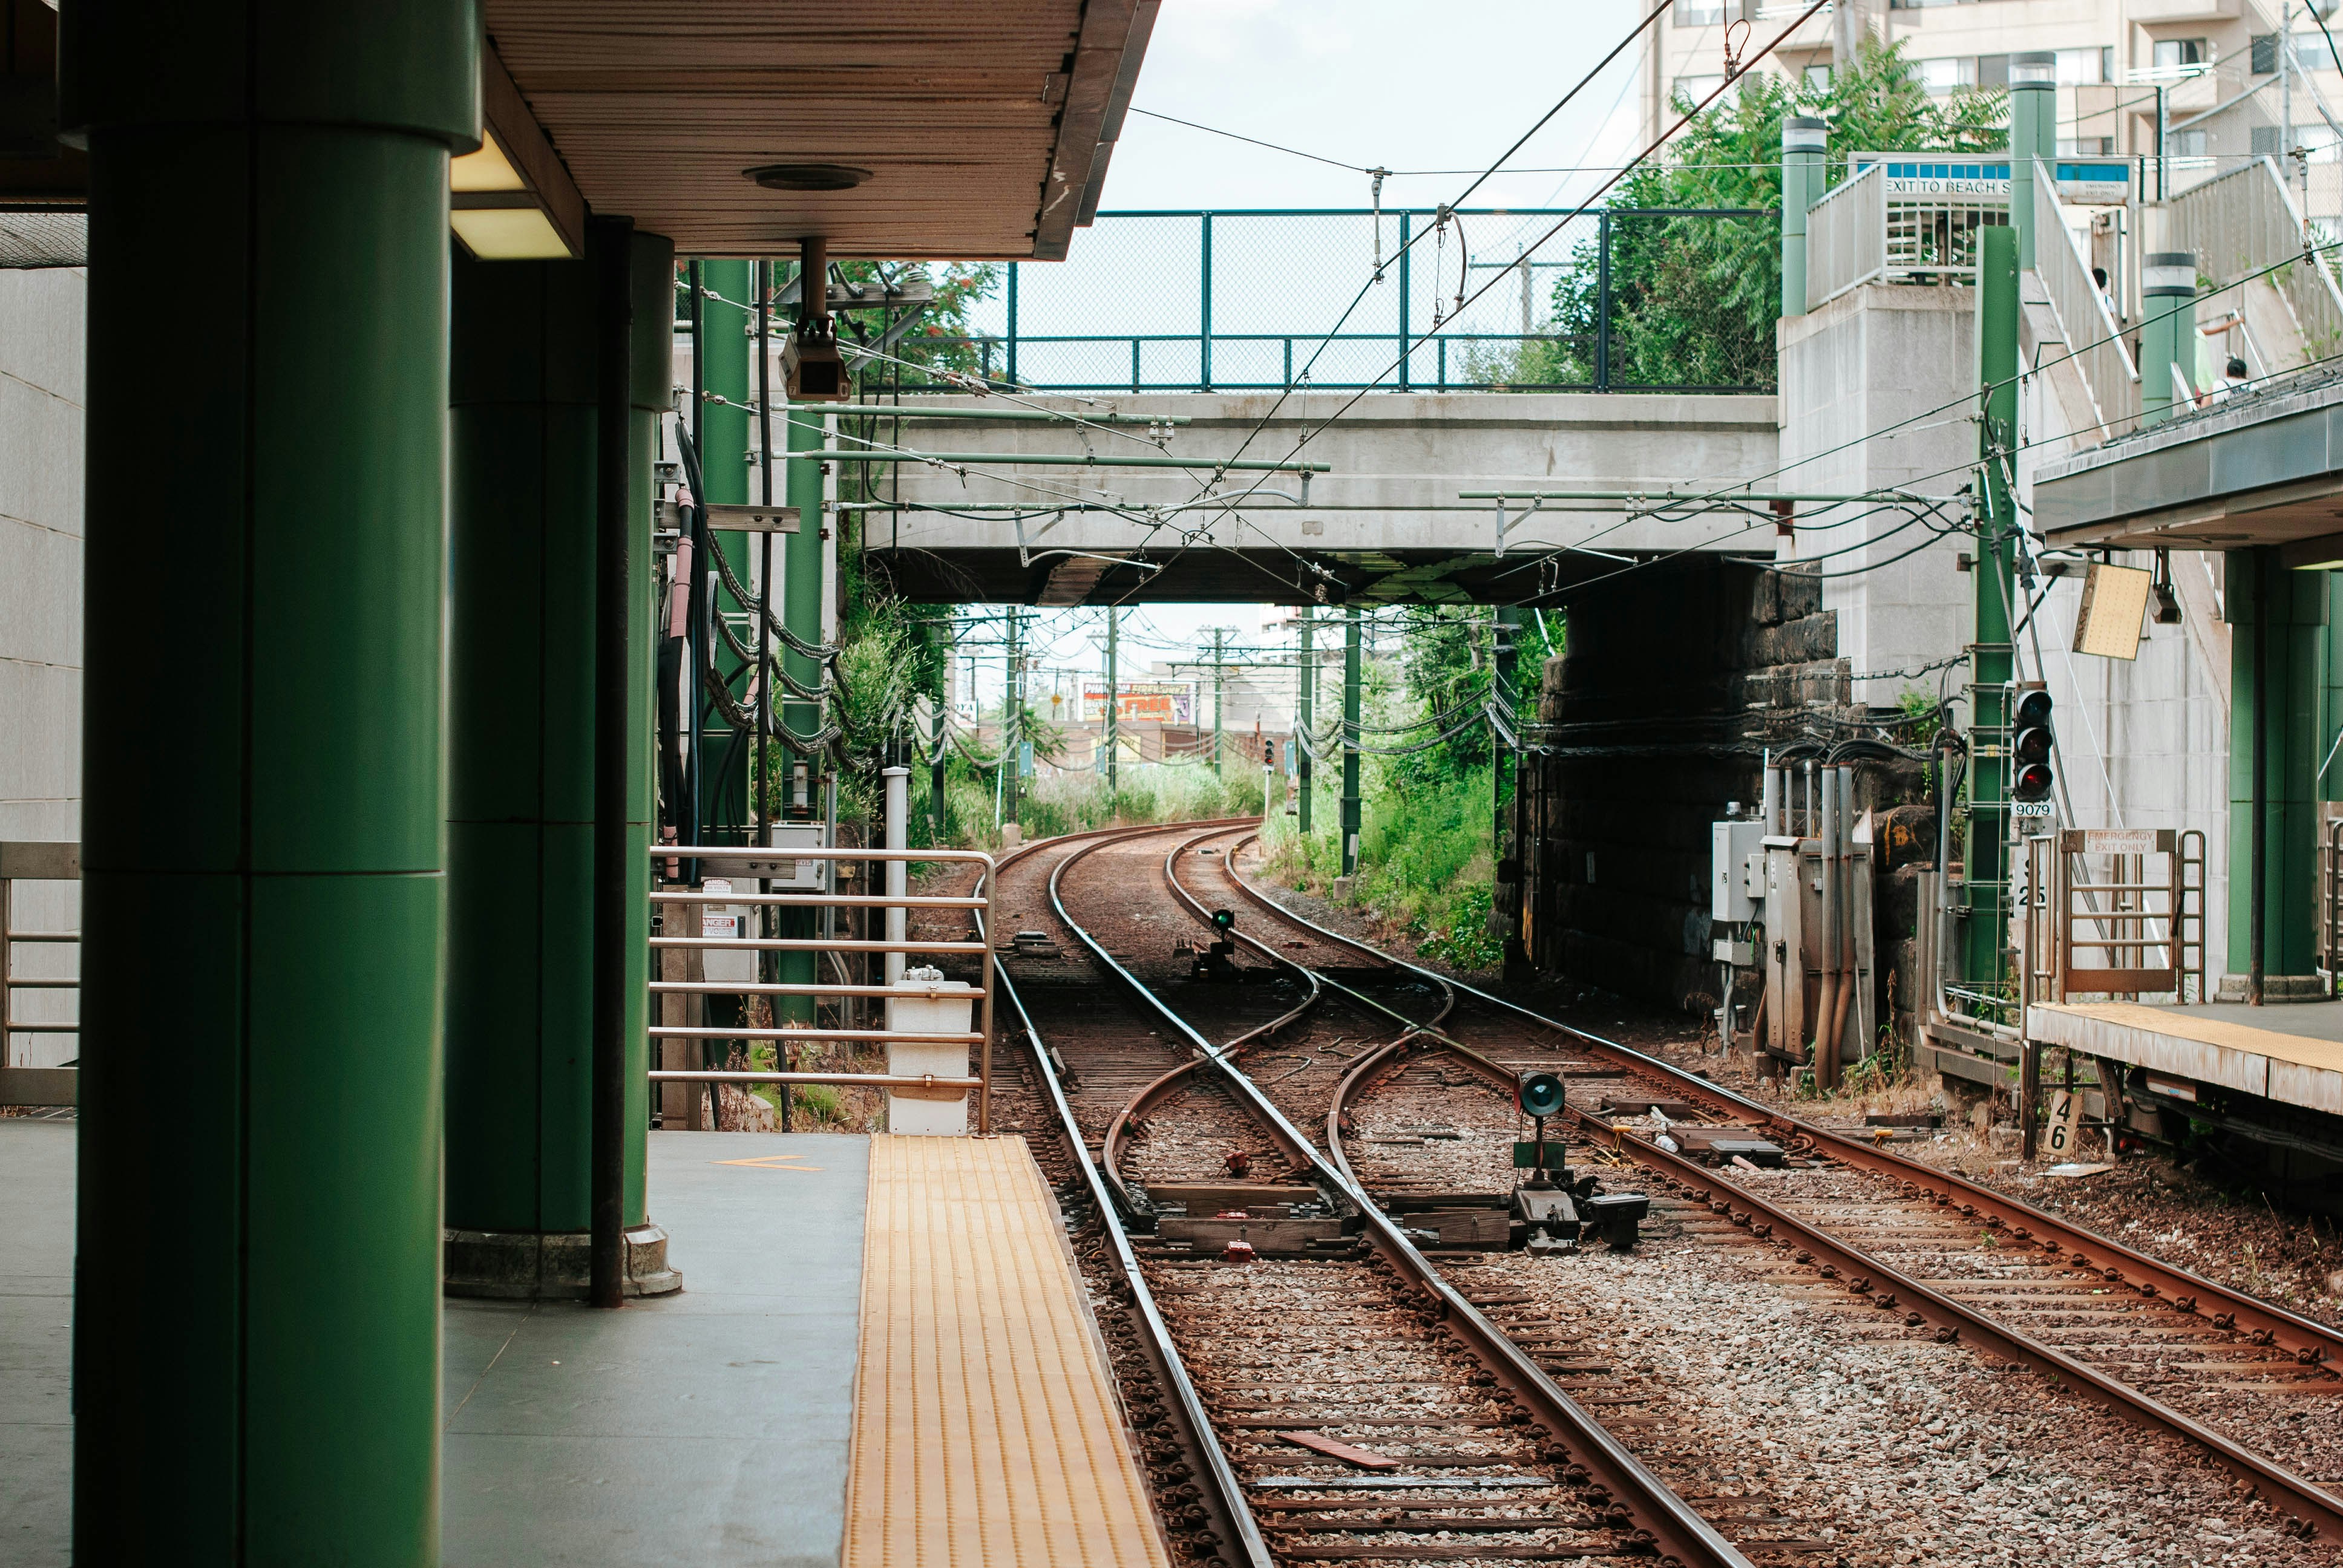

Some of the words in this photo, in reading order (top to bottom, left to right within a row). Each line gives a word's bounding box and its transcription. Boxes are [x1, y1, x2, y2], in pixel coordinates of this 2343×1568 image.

[1886, 181, 1914, 192] EXIT
[1919, 181, 1940, 192] TO
[1946, 181, 1996, 194] BEACH
[1126, 698, 1171, 714] FREE
[2016, 804, 2050, 815] 9079
[2087, 831, 2153, 841] EMERGENCY
[2095, 843, 2117, 852] EXIT
[2120, 843, 2146, 852] ONLY
[2056, 1096, 2072, 1123] 4
[2051, 1125, 2067, 1150] 6
